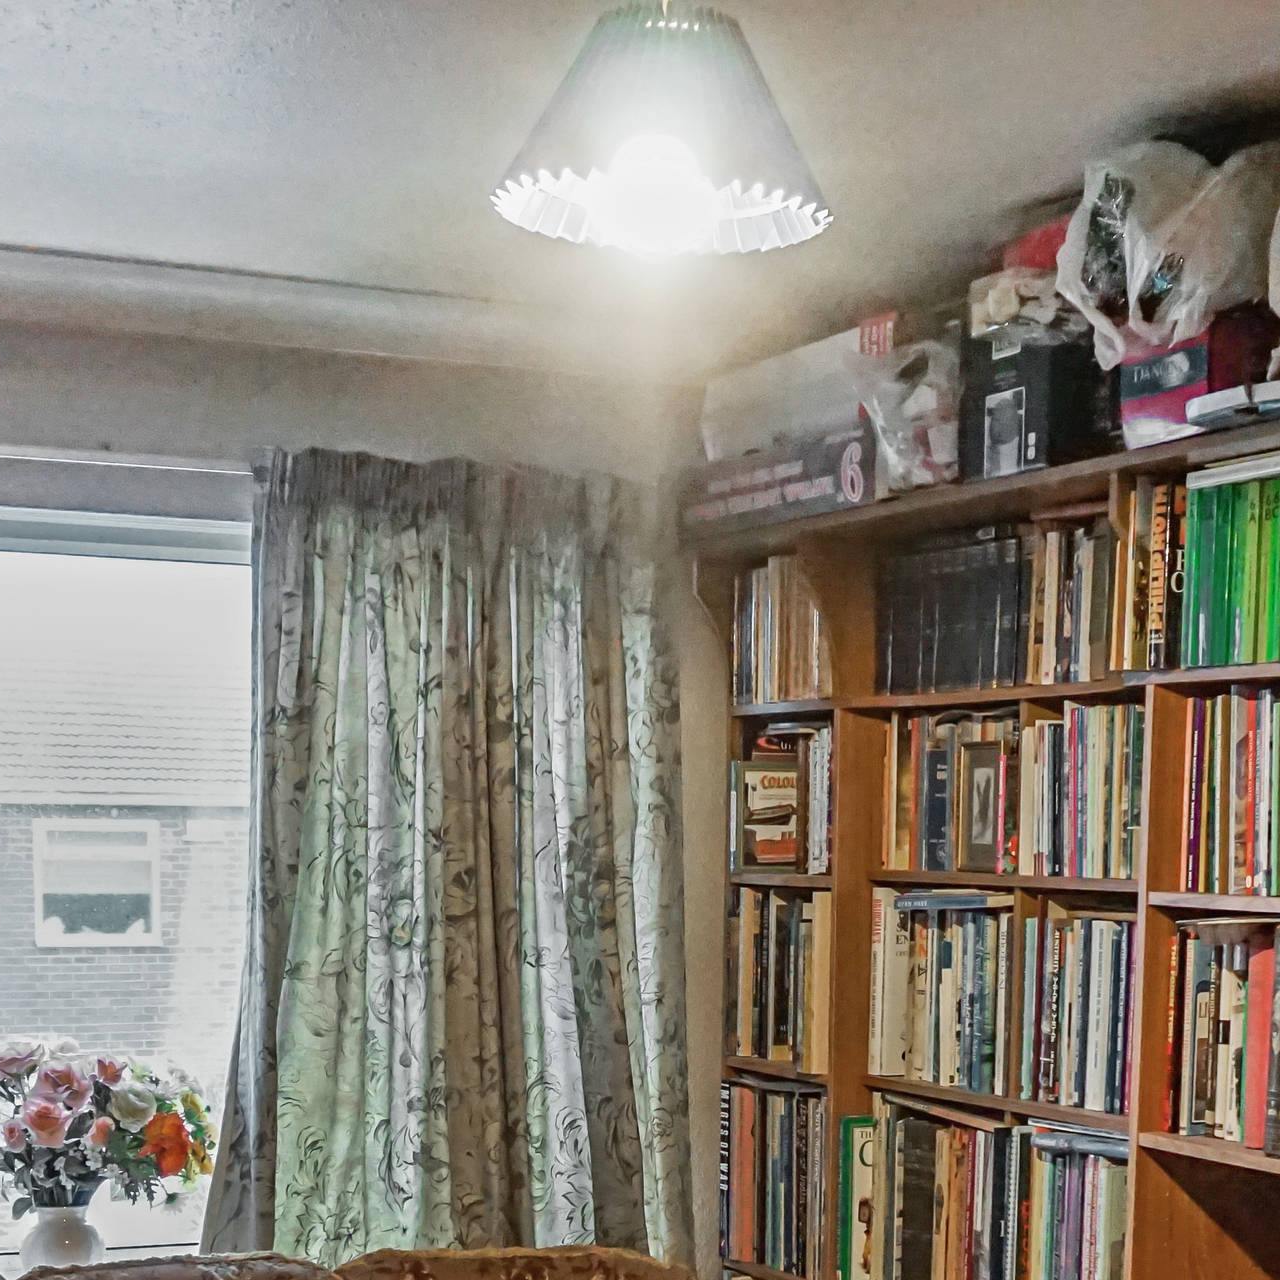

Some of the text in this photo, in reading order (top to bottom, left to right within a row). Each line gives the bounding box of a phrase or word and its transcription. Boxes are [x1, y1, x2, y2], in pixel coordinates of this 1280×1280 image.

[1151, 484, 1167, 549] ROTH
[1149, 551, 1163, 630] PHILIP
[719, 1083, 729, 1192] IMAGES OF WAR
